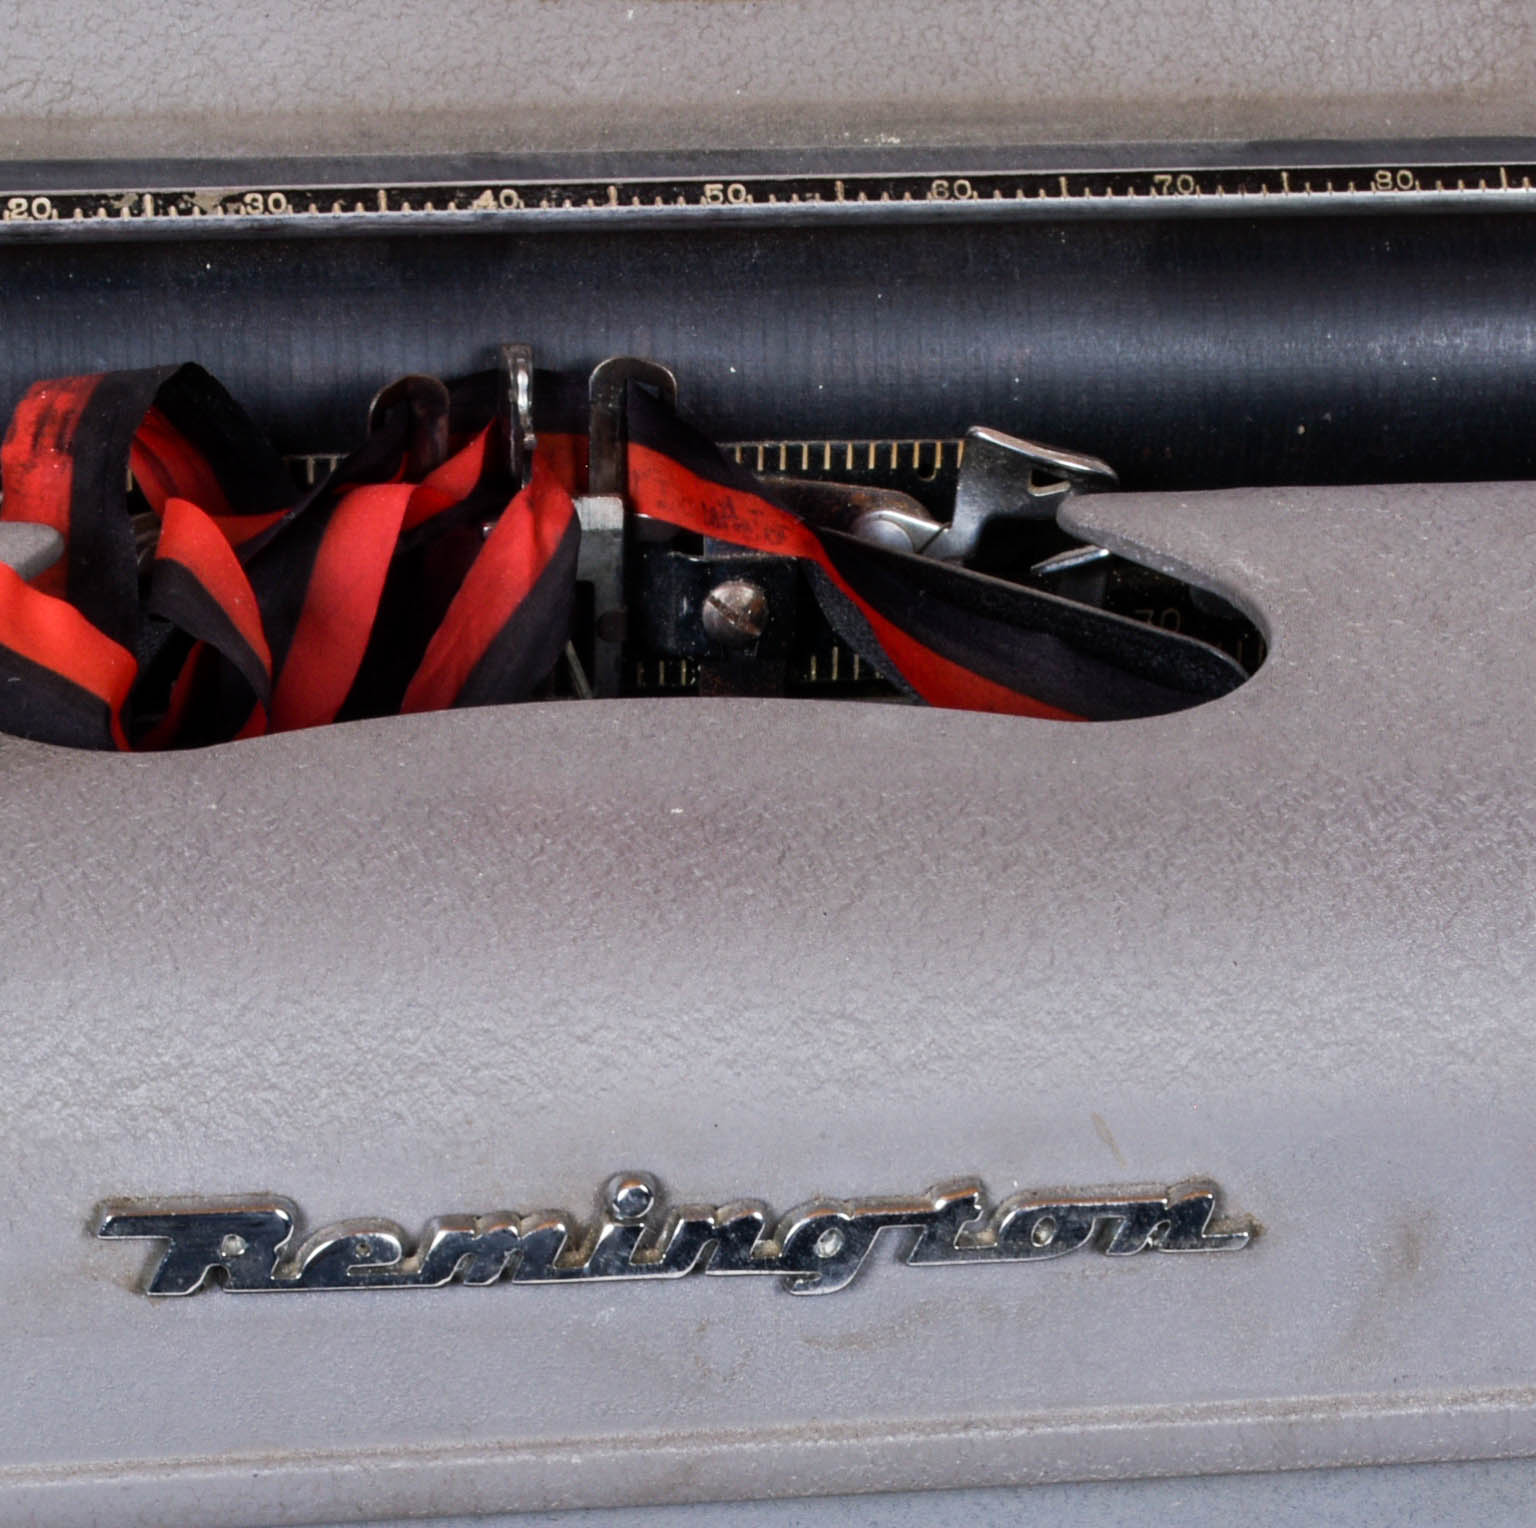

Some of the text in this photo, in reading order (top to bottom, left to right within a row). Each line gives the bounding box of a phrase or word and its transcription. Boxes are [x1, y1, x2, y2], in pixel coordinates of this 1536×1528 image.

[7, 197, 51, 221] 20
[244, 192, 287, 216] 30
[472, 189, 516, 211] 40
[704, 183, 746, 206] 50
[930, 179, 972, 201] 60
[1153, 174, 1194, 196] 70
[1374, 169, 1413, 191] 80
[94, 1174, 1253, 1297] Remington
